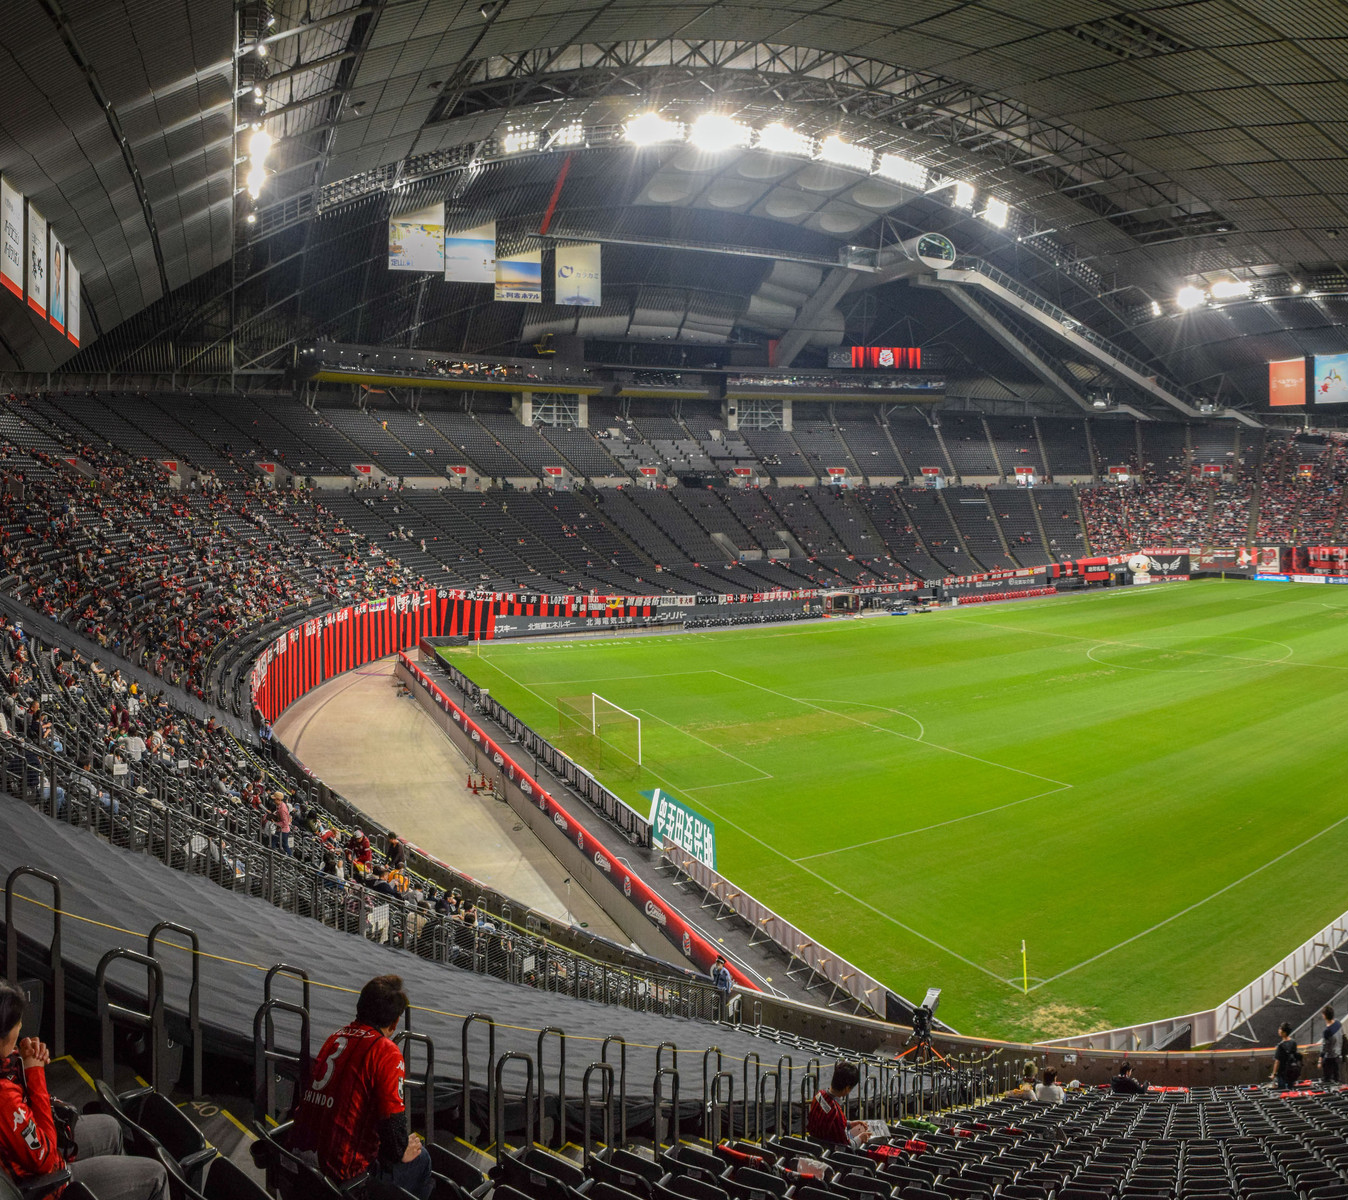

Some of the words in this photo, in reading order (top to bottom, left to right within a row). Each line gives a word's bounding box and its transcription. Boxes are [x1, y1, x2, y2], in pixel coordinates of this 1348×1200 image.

[520, 595, 537, 603] 白井
[527, 620, 577, 631] 北海道エネルギー
[657, 797, 713, 868] 明治安田生命
[312, 1036, 348, 1090] 3
[303, 1090, 334, 1108] SHINDO
